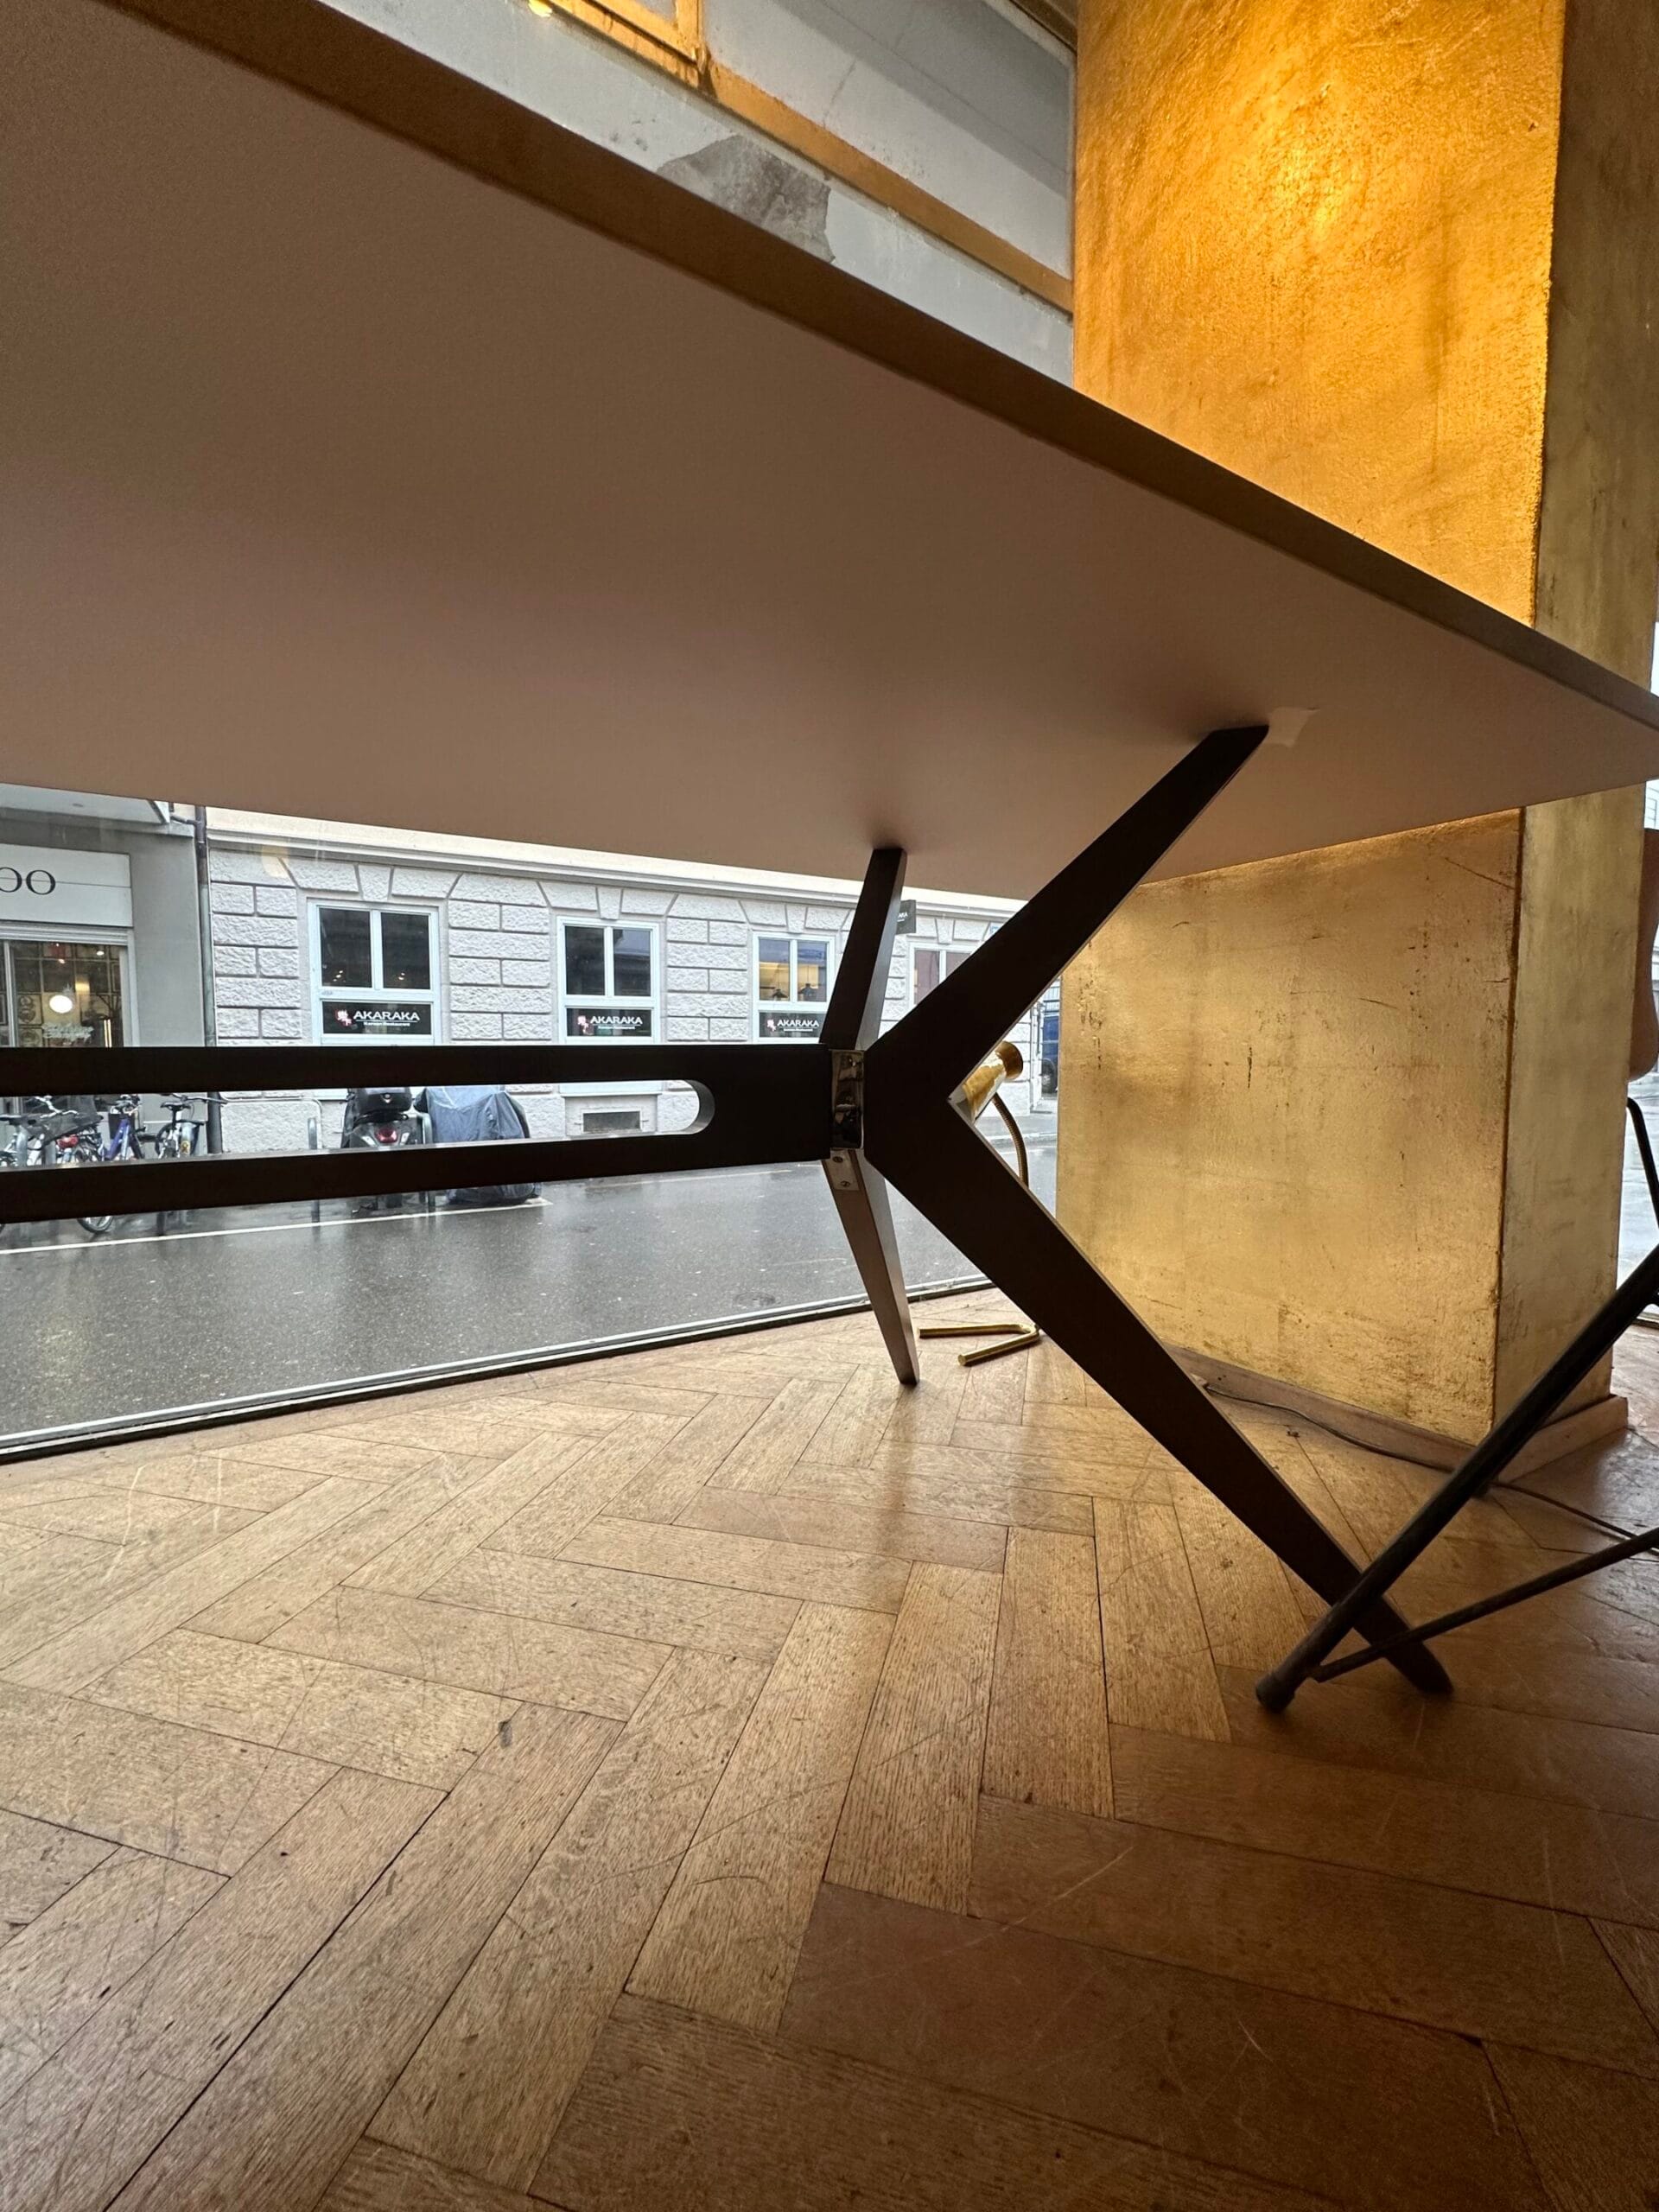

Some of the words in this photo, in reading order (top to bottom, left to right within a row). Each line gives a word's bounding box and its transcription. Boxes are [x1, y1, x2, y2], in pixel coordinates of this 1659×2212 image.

[353, 1010, 420, 1020] AKARAKA
[589, 1015, 643, 1025] AKARAKA
[777, 1019, 820, 1027] AKARAKA
